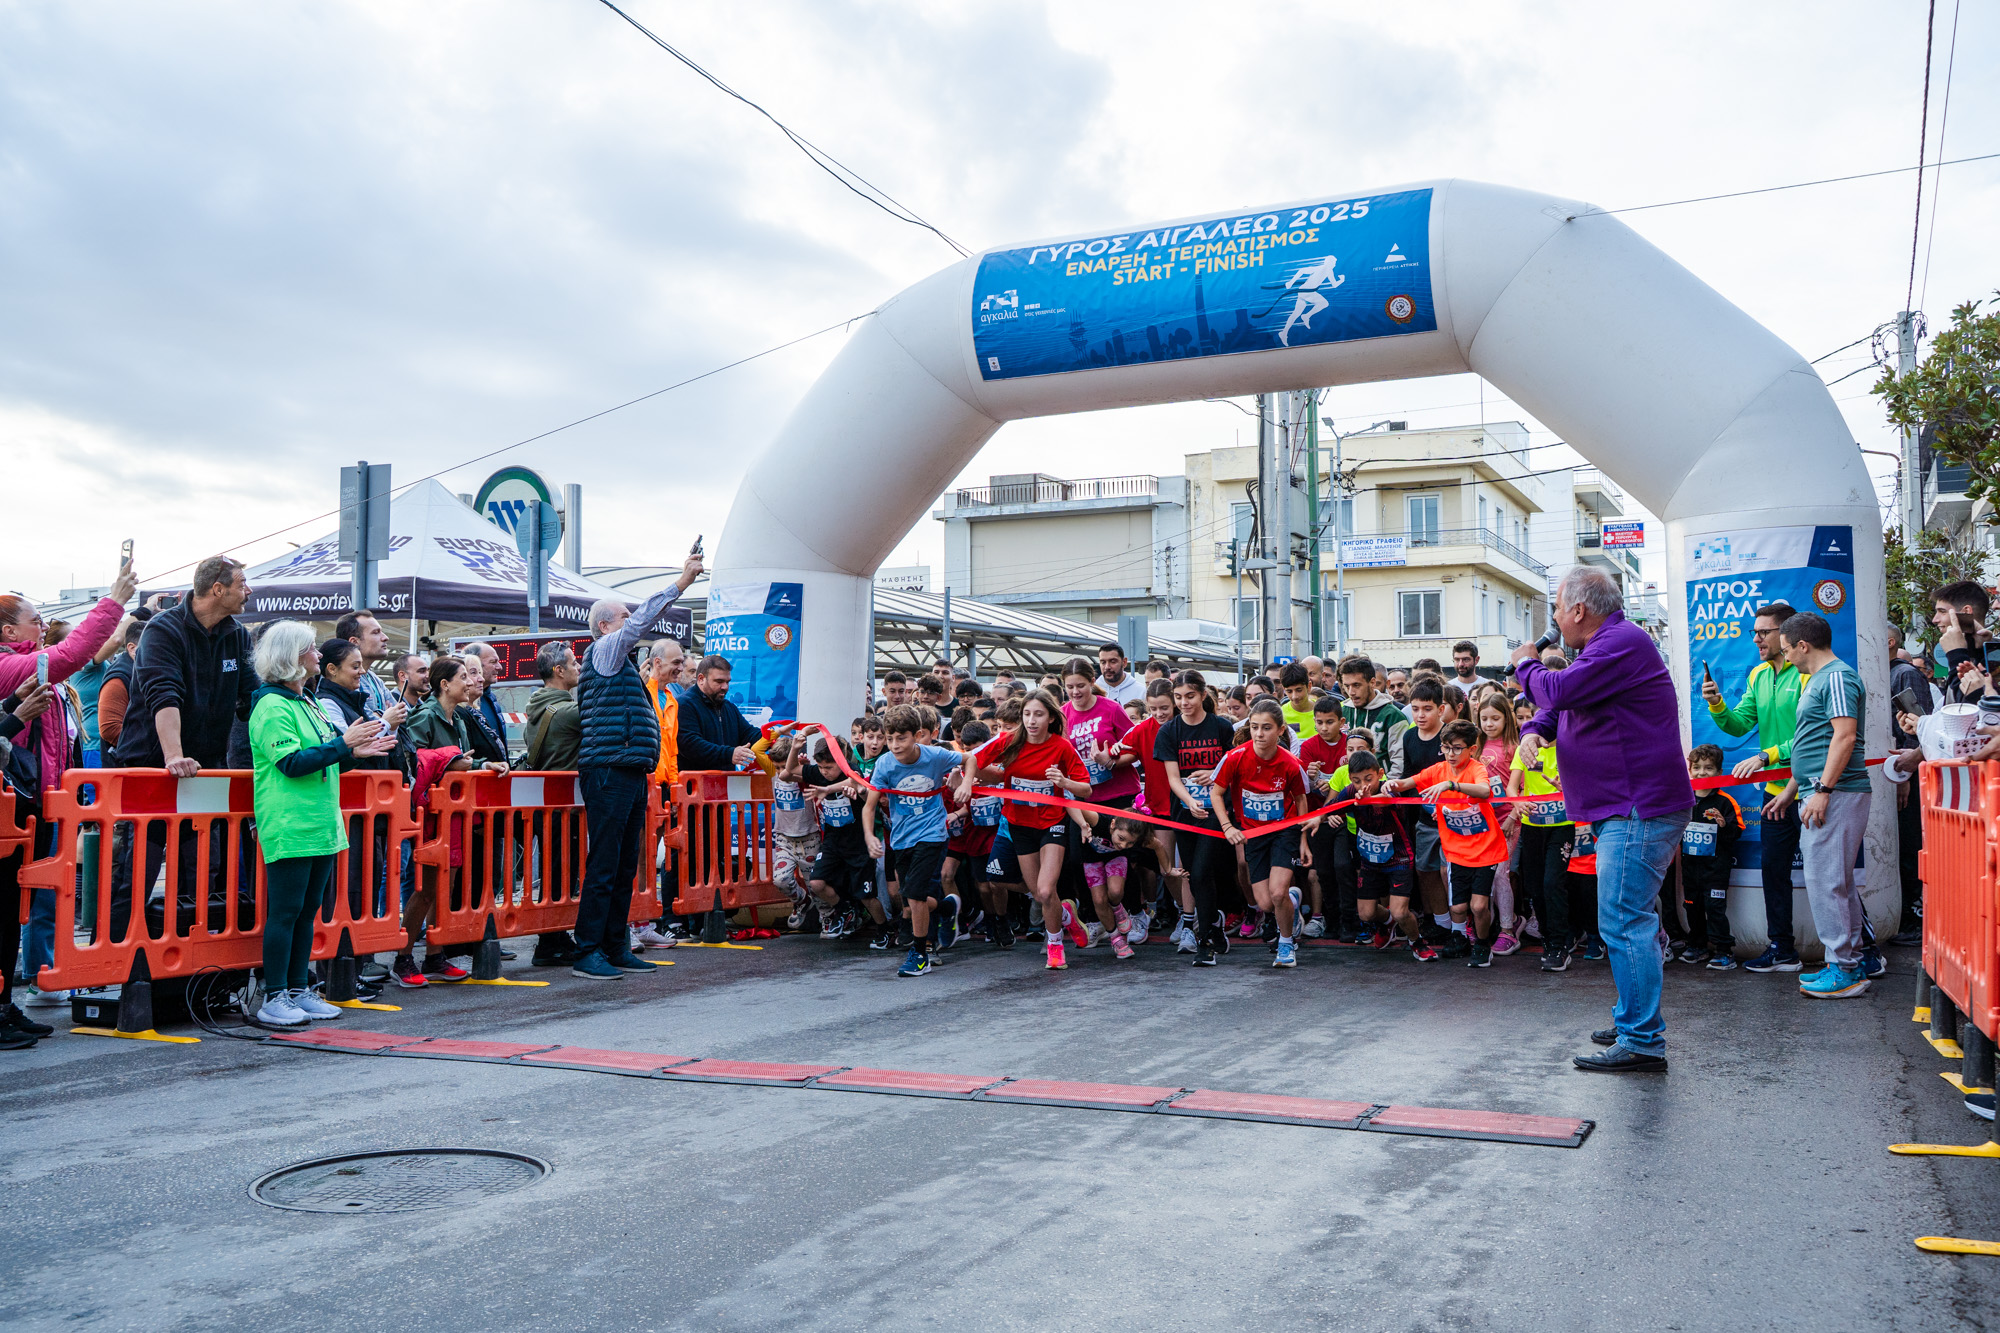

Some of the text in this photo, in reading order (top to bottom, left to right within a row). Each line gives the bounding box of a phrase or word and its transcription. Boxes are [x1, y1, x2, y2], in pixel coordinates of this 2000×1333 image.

[1028, 200, 1370, 265] ΓΥΡΟΣ ΑΙΓΑΛΕΩ 2025
[1066, 252, 1148, 276] ΕΝΑΡΞΗ
[1168, 228, 1320, 262] ΤΕΡΜΑΤΙΣΜΟΣ
[1112, 263, 1175, 286] START
[1195, 251, 1264, 275] FINISH
[980, 308, 1019, 324] αγκαλιά
[881, 575, 924, 583] ΜΑΘΗΣΗΣ
[1694, 579, 1763, 600] ΓΥΡΟΣ
[256, 593, 410, 614] www.esportevs.gr
[706, 621, 734, 638] ΓΥΡΟΣ
[1694, 621, 1742, 640] 2025
[704, 637, 750, 653] ΑΙΓΑΛΕΩ
[1069, 716, 1102, 739] JUST
[275, 738, 293, 747] Zeus
[1180, 738, 1218, 748] YMPIACO
[1179, 750, 1221, 767] IRAEUS
[1090, 763, 1107, 775] 56
[775, 790, 800, 801] 2207
[1186, 786, 1214, 798] 248
[824, 806, 850, 818] 3958
[1245, 800, 1280, 812] 2061
[1446, 814, 1483, 827] 2058
[1574, 834, 1591, 847] 72
[1683, 832, 1713, 844] 3899
[1359, 839, 1390, 853] 2167
[985, 867, 1004, 876] adidas
